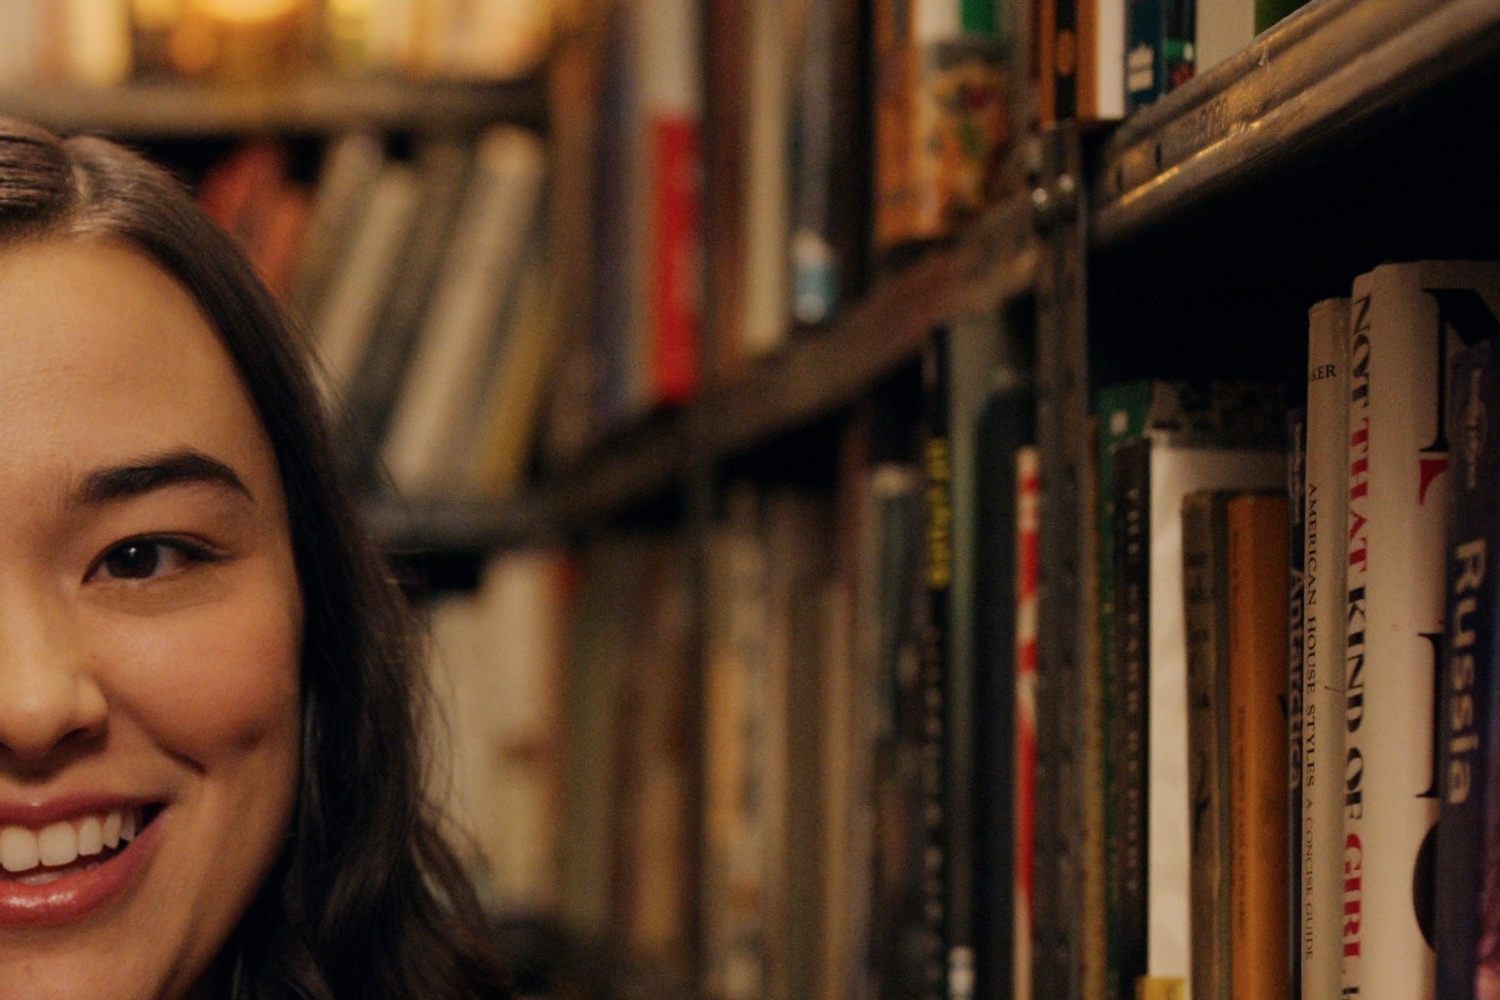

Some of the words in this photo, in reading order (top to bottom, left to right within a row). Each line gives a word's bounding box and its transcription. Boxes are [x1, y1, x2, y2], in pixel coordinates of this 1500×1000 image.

[1352, 294, 1373, 409] NOT
[1307, 482, 1318, 606] AMERICAN
[1350, 417, 1370, 573] THAT
[1306, 616, 1317, 694] HOUSE
[1347, 584, 1367, 734] KIND
[1448, 537, 1488, 804] Russia
[1305, 705, 1316, 788] STYLES
[1345, 746, 1365, 821] OF
[1305, 816, 1314, 897] CONCISE
[1305, 902, 1314, 960] GUIDE
